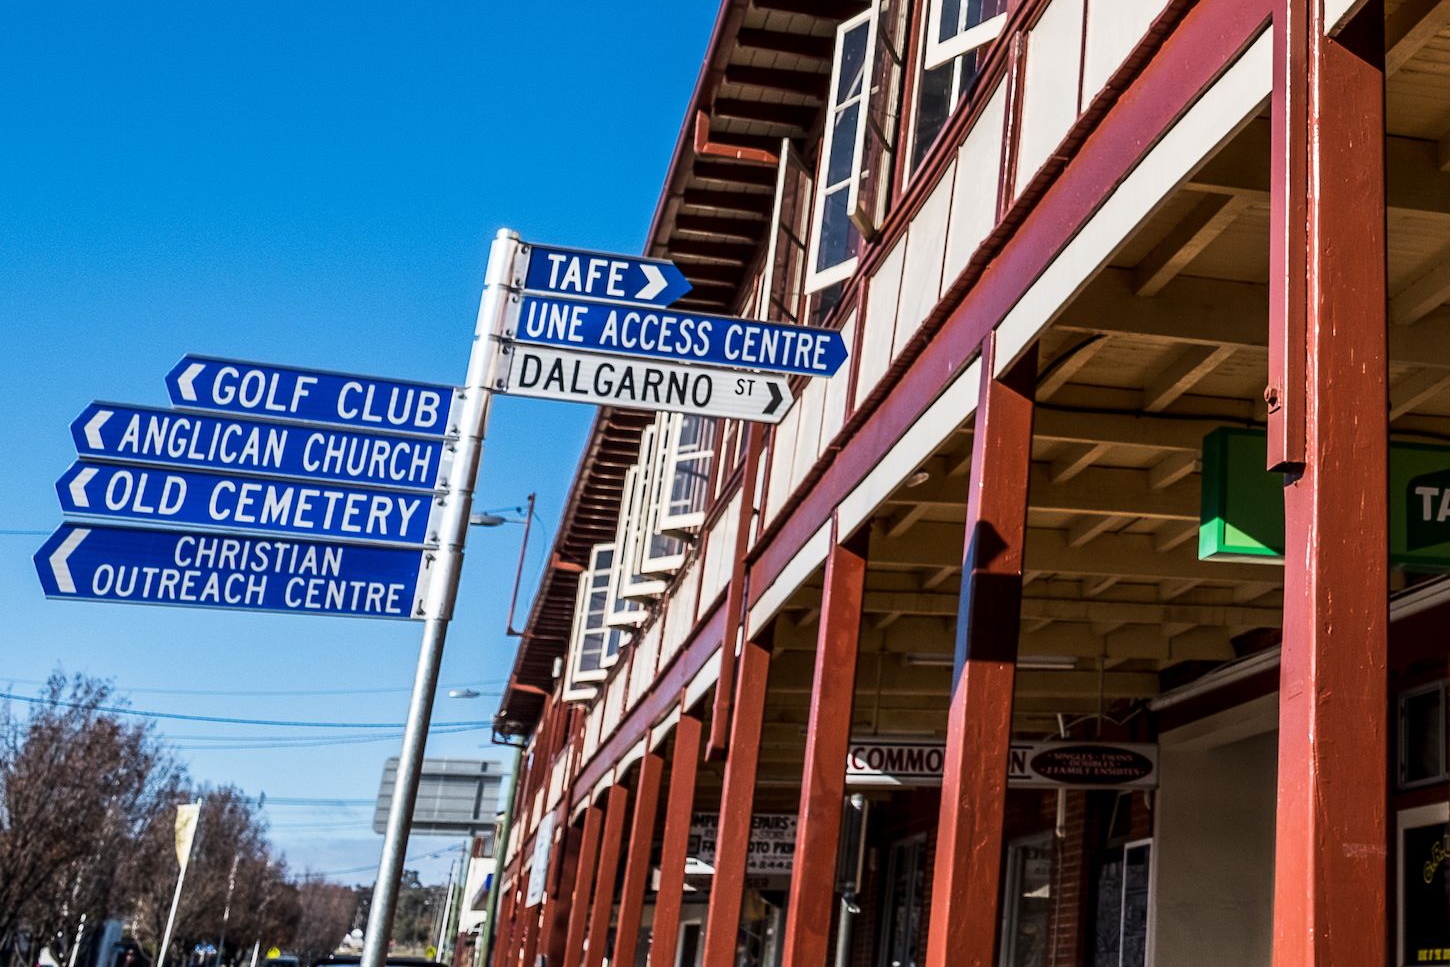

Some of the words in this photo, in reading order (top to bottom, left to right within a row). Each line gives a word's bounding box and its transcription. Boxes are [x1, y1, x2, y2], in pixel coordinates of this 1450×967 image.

[546, 254, 629, 297] TAFE
[526, 301, 588, 342] UNE
[599, 310, 713, 357] ACCESS
[724, 324, 832, 371] CENTRE
[211, 367, 318, 413] GOLF
[337, 381, 441, 428] CLUB
[518, 354, 713, 408] DALGARNO
[735, 378, 757, 397] ST
[117, 414, 288, 468] ANGLICAN
[302, 433, 432, 483] CHURCH
[105, 471, 188, 515] OLD
[208, 481, 421, 537] CEMETERY
[174, 536, 343, 578] CHRISTIAN
[92, 564, 267, 605] OUTREACH
[284, 577, 405, 614] CENTRE
[752, 817, 790, 830] EPAIRS
